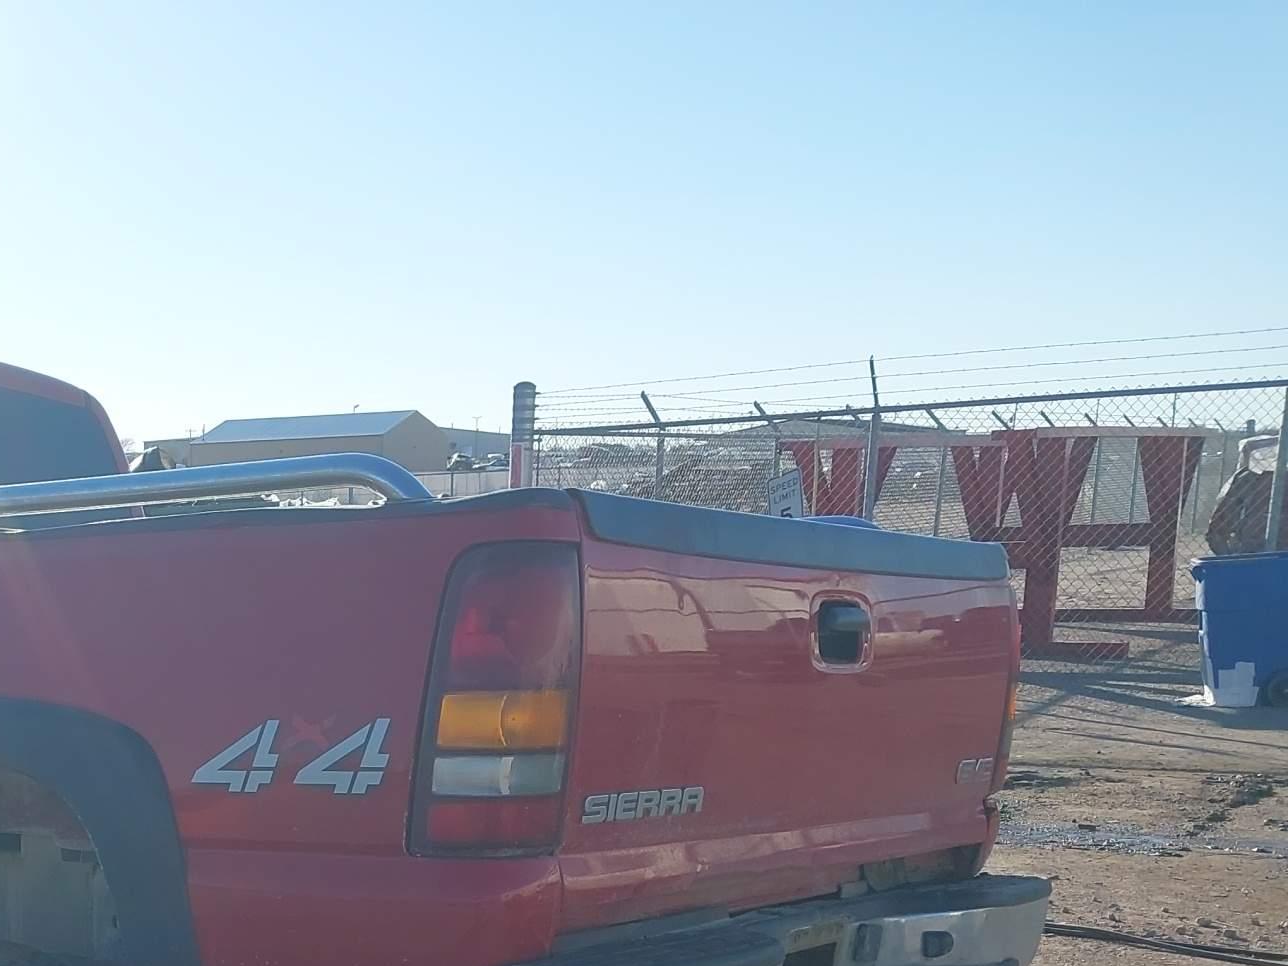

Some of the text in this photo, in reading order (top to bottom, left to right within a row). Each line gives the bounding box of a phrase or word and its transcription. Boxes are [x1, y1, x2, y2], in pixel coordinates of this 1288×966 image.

[771, 477, 798, 495] SPEED
[773, 488, 797, 505] LIMIT
[581, 786, 705, 825] SIERRA
